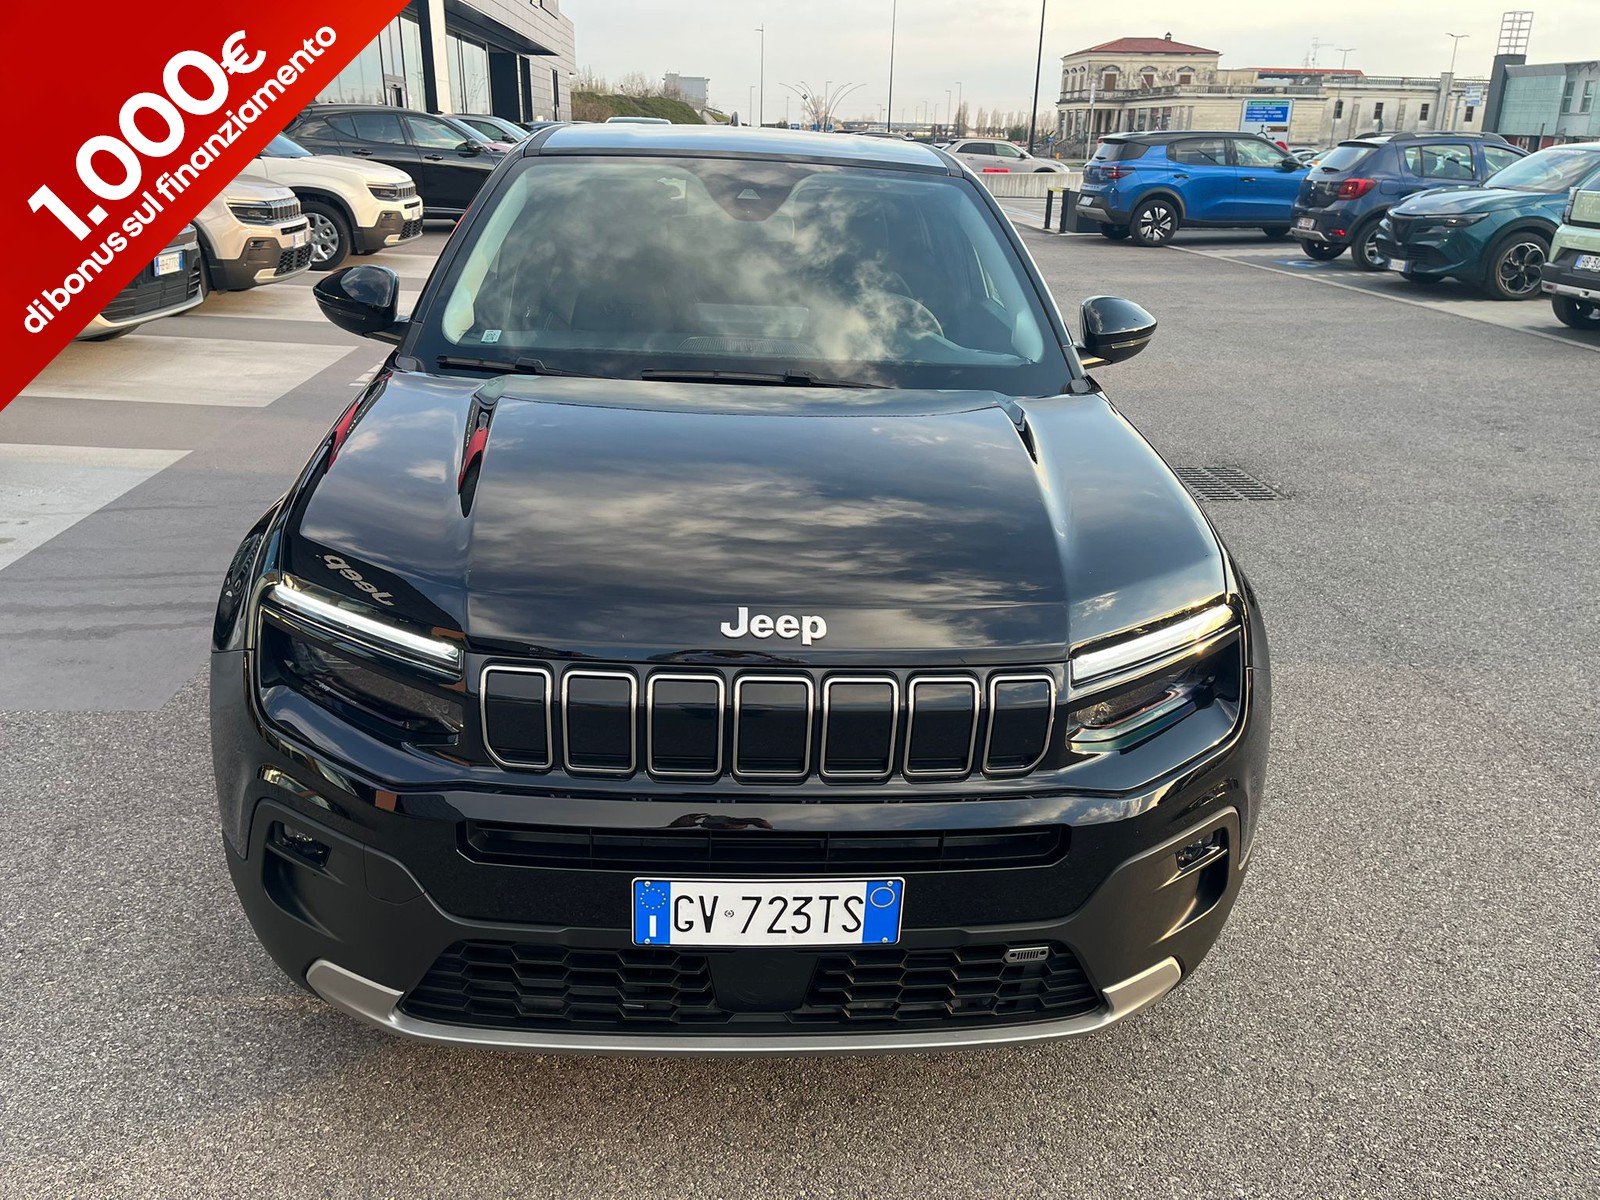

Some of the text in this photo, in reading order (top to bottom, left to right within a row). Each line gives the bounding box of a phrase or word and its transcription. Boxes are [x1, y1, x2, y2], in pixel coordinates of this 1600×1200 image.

[721, 606, 827, 646] Jeep
[673, 894, 719, 934] GV
[741, 894, 865, 934] 723TS
